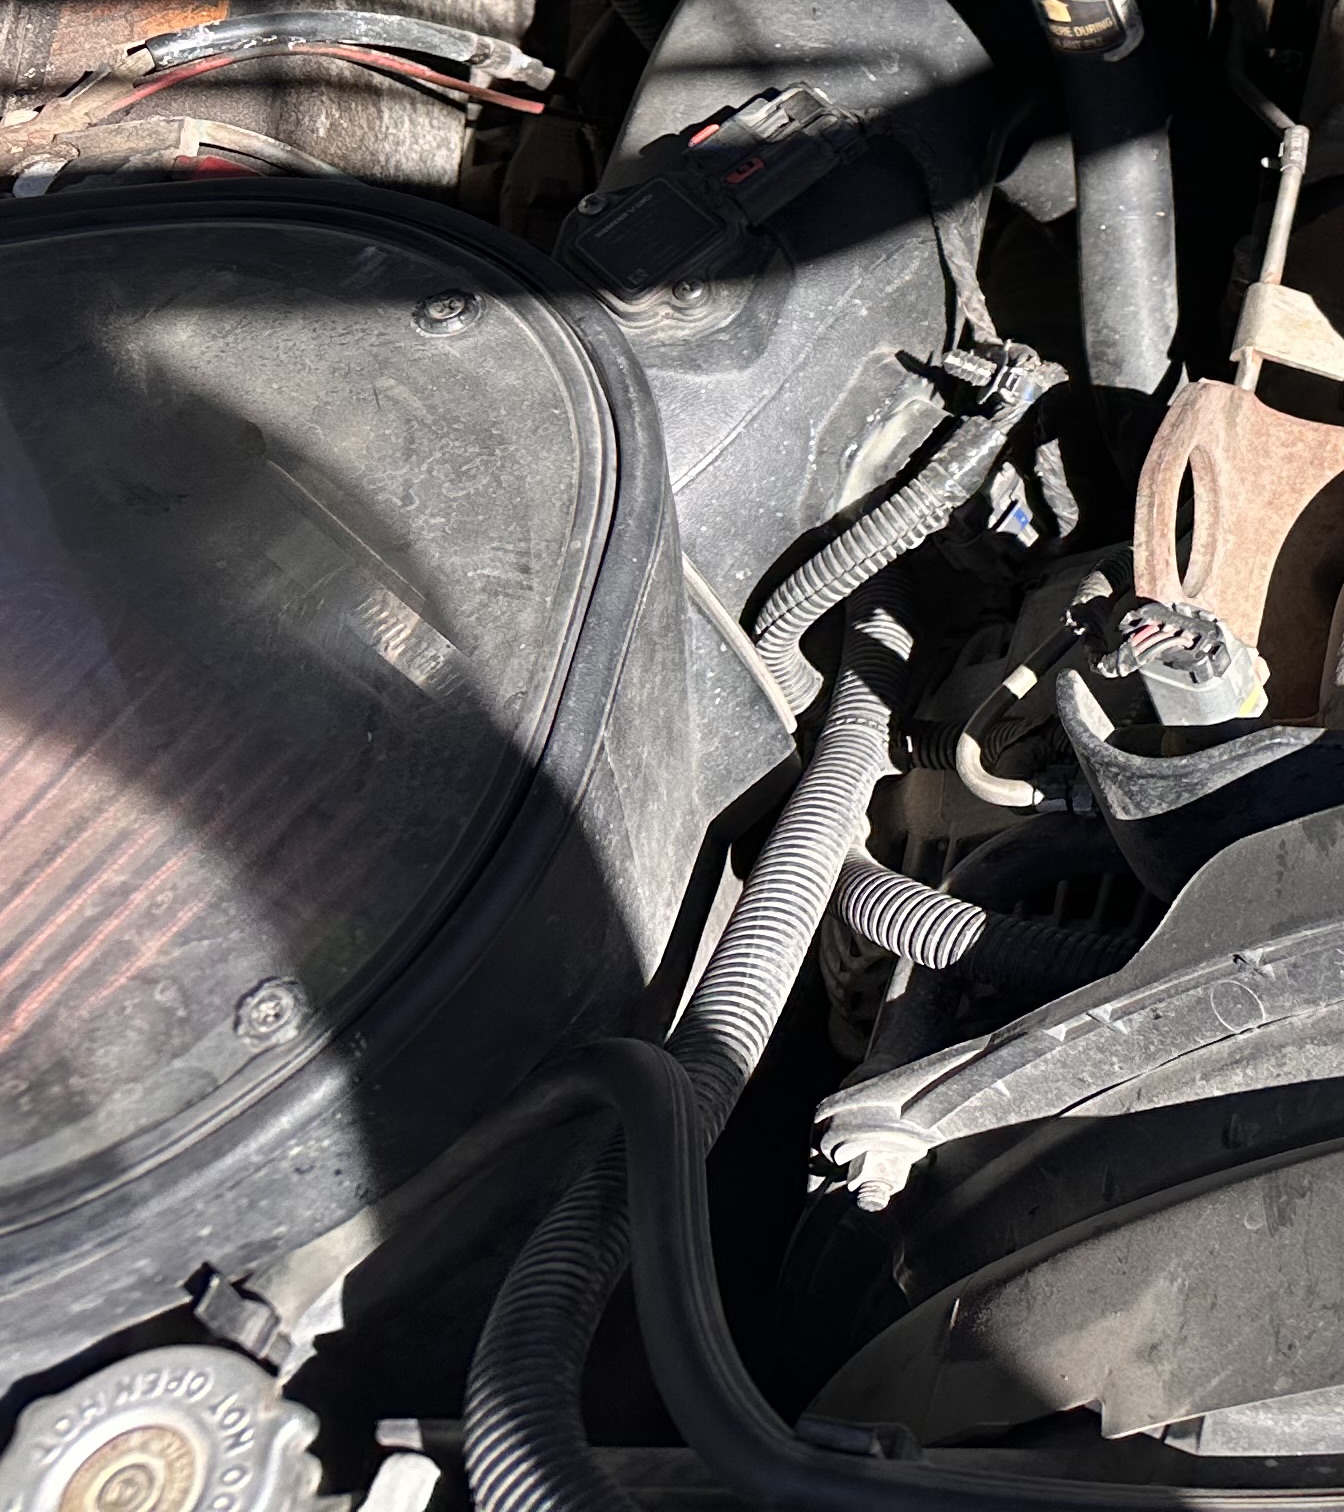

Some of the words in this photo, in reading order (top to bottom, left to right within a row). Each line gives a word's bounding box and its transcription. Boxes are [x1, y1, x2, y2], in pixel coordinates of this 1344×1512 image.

[1073, 16, 1114, 37] DURING
[114, 1366, 215, 1407] OPEN
[208, 1392, 256, 1459] NOT
